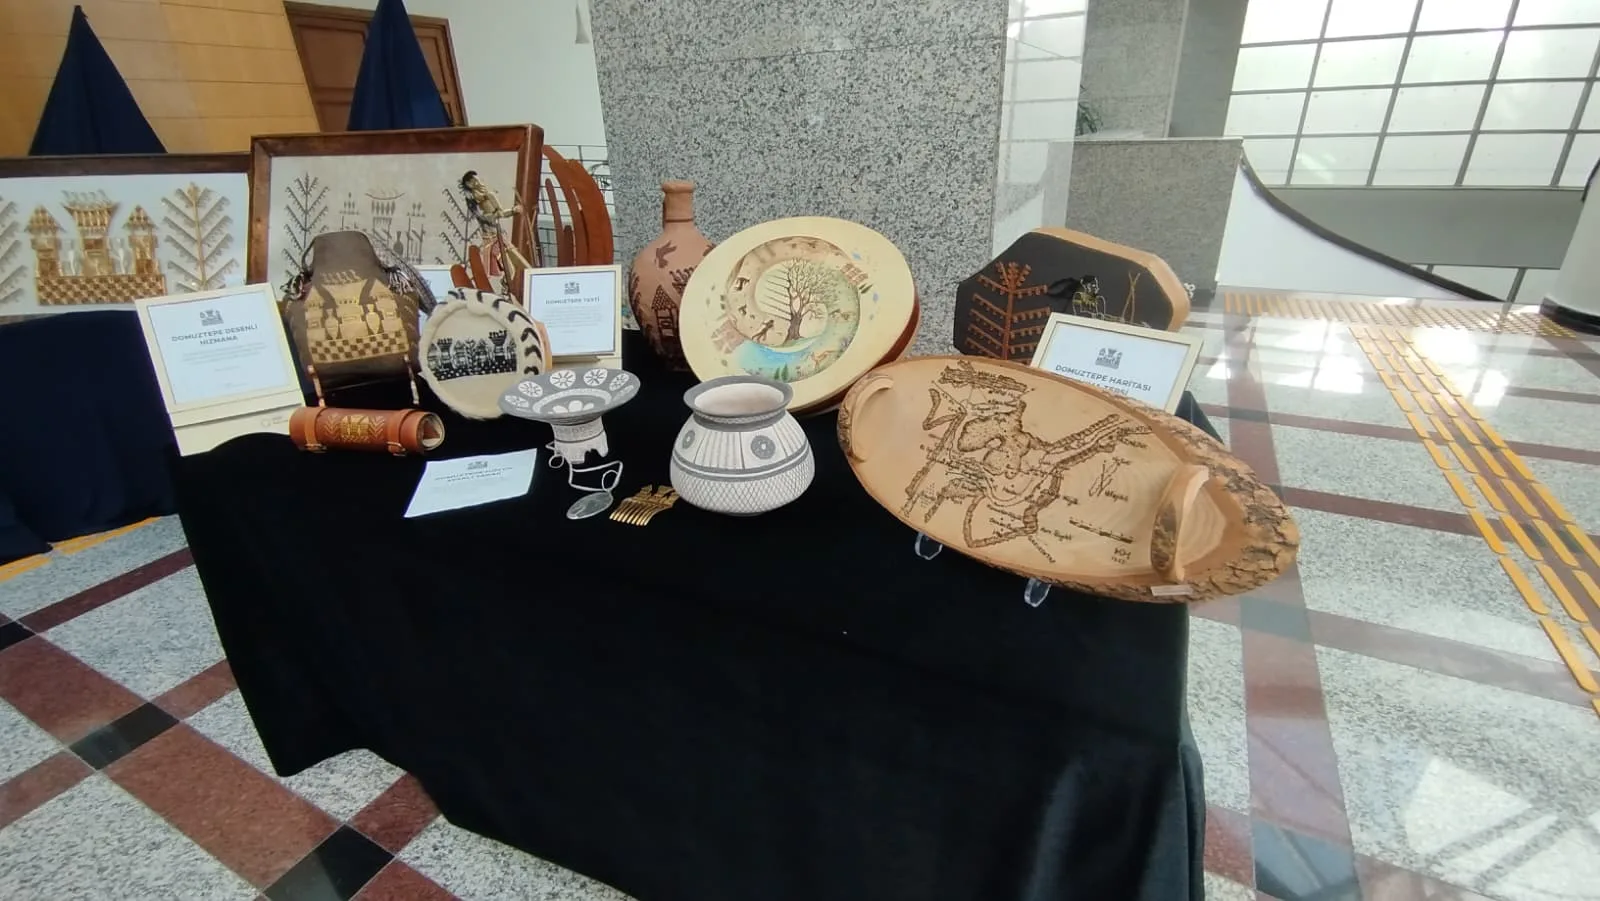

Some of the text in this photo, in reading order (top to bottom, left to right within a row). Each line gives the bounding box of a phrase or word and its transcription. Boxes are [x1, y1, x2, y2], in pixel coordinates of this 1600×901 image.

[172, 329, 223, 342] DOMUZTEPE
[1055, 364, 1109, 381] DOMUZTEPE
[1109, 376, 1152, 392] HARİTASI
